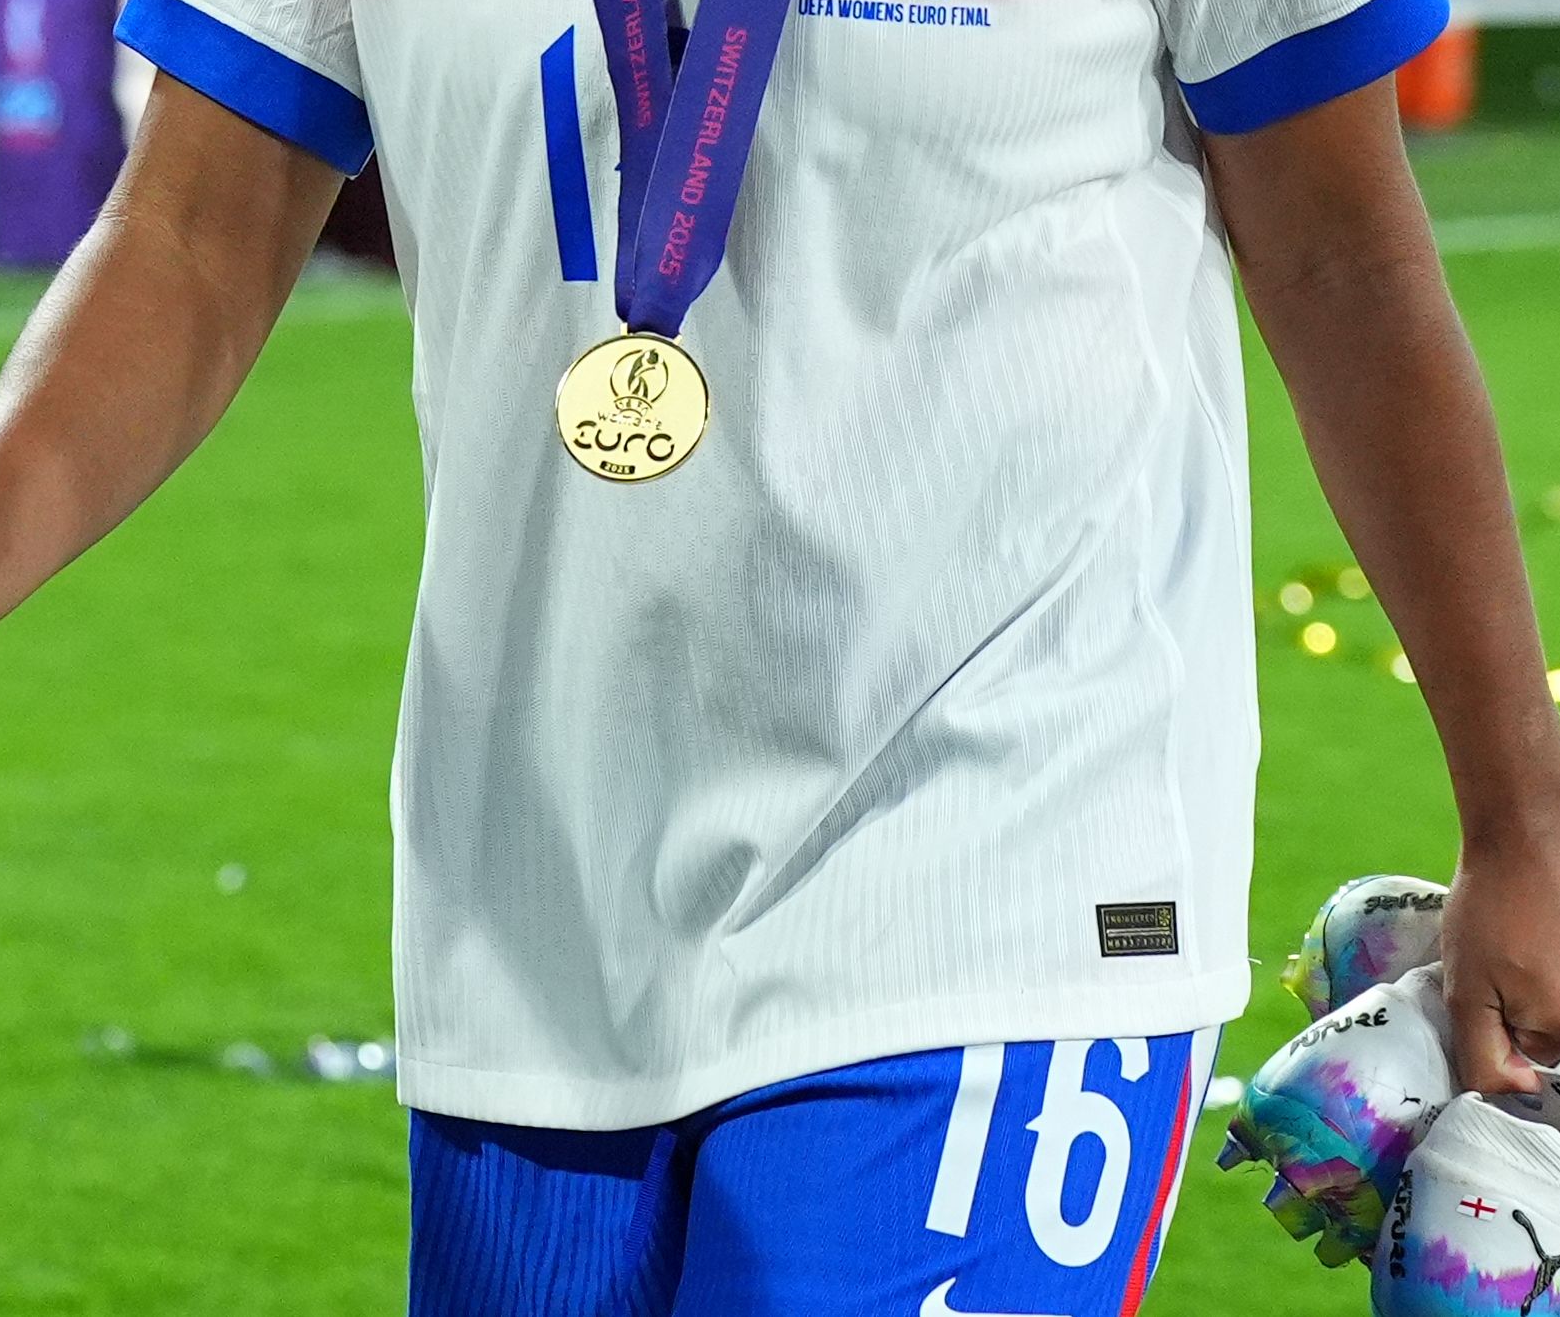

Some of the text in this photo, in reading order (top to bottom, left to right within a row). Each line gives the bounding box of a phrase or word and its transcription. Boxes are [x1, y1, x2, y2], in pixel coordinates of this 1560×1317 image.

[839, 0, 903, 22] WOMENS
[908, 4, 946, 25] EURO
[951, 6, 991, 27] FINAL
[658, 27, 748, 276] SWITZERLAND 2025
[925, 1036, 1150, 1268] 16
